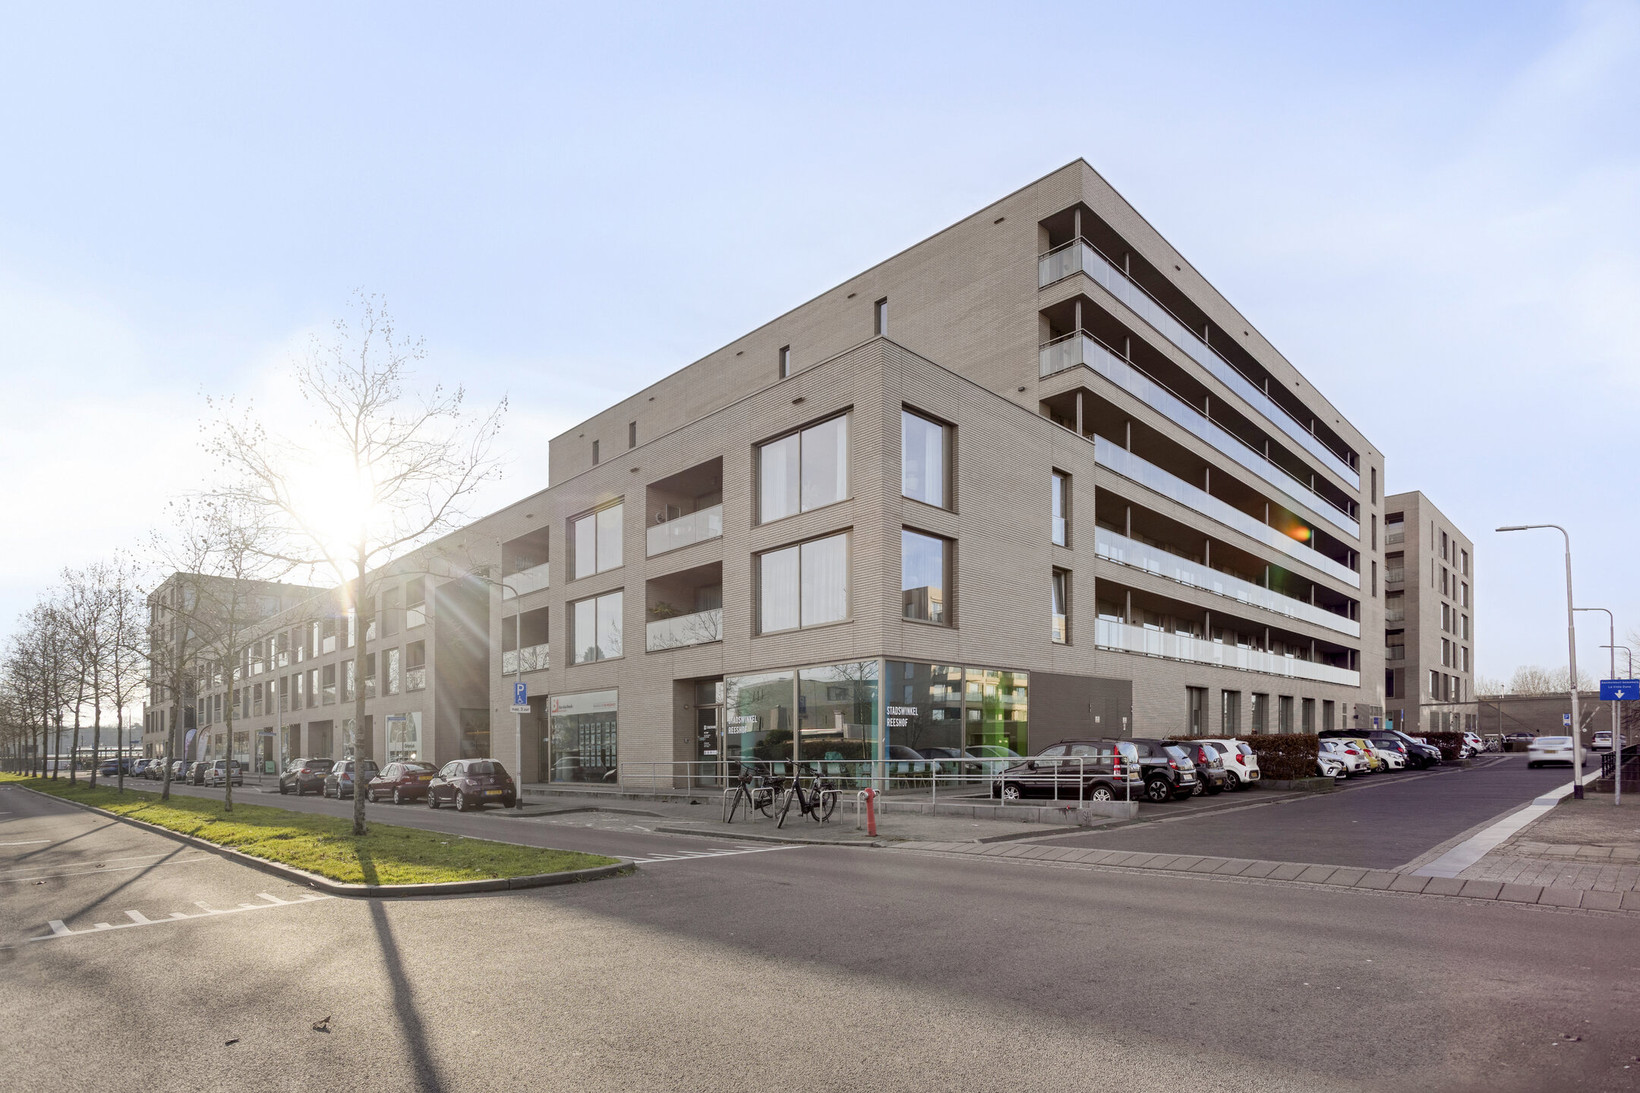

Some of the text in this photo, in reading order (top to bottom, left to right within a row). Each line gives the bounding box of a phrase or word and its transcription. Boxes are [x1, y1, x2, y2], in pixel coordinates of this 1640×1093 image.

[517, 684, 525, 696] P
[886, 706, 919, 716] STADSWINKEL
[886, 718, 909, 727] REESHOF
[727, 725, 748, 735] REESHOF
